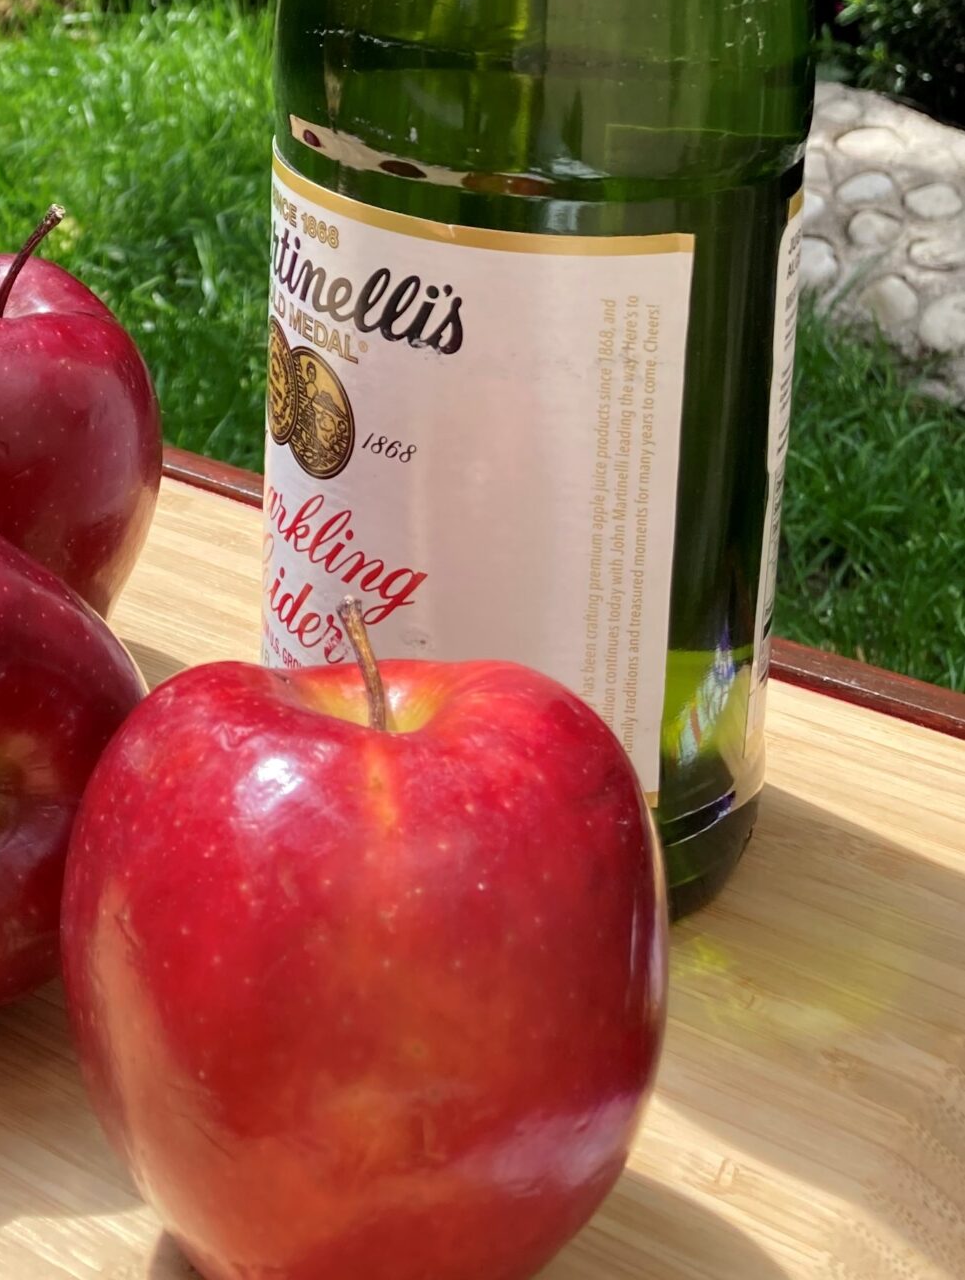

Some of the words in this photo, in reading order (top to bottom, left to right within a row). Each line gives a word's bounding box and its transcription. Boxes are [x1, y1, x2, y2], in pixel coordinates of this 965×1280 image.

[301, 212, 339, 249] 1868
[271, 221, 464, 355] rtinelli's
[626, 295, 638, 307] to
[600, 298, 616, 324] and
[643, 303, 661, 352] Cheers!
[598, 327, 616, 361] 1868,
[622, 311, 638, 351] Here's
[597, 367, 612, 401] since
[644, 356, 658, 393] come.
[618, 385, 634, 406] the
[641, 398, 654, 410] to
[594, 403, 612, 459] products
[615, 410, 637, 457] leading
[641, 413, 656, 446] years
[361, 432, 418, 463] 1868
[591, 462, 609, 493] juice
[639, 449, 655, 484] many
[612, 461, 629, 521] Martinelli
[634, 487, 649, 504] for
[589, 495, 608, 530] apple
[610, 524, 625, 556] John
[634, 507, 649, 566] moments
[268, 486, 428, 625] arkling
[586, 533, 605, 591] premium
[608, 559, 624, 585] with
[606, 587, 626, 622] today
[629, 569, 644, 626] treasured
[583, 594, 604, 639] crafting
[580, 643, 596, 672] been
[603, 626, 619, 684] continues
[626, 630, 640, 653] and
[580, 677, 595, 697] has
[622, 656, 639, 713] traditions
[601, 688, 615, 728] dition
